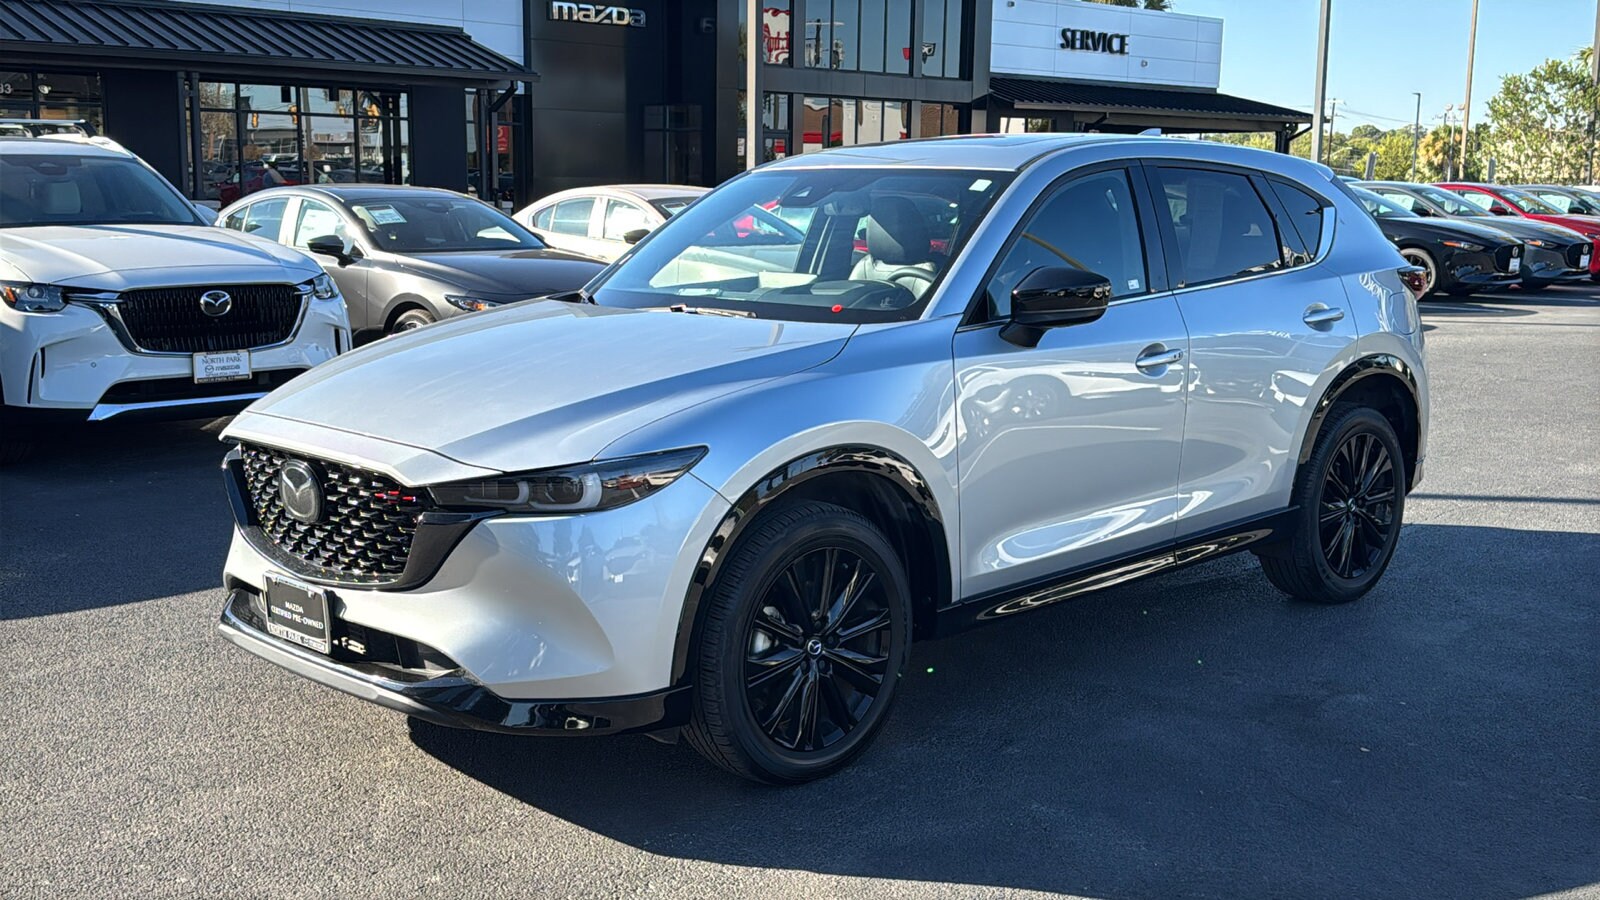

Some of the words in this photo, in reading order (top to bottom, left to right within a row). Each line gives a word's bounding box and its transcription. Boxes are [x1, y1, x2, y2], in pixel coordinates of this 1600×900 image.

[551, 1, 646, 27] mazda
[1060, 28, 1129, 55] SERVICE
[202, 356, 224, 364] NORTH
[270, 606, 292, 619] CERTIFIED
[292, 614, 324, 630] PRE-OWNED
[285, 601, 304, 613] MAZDA
